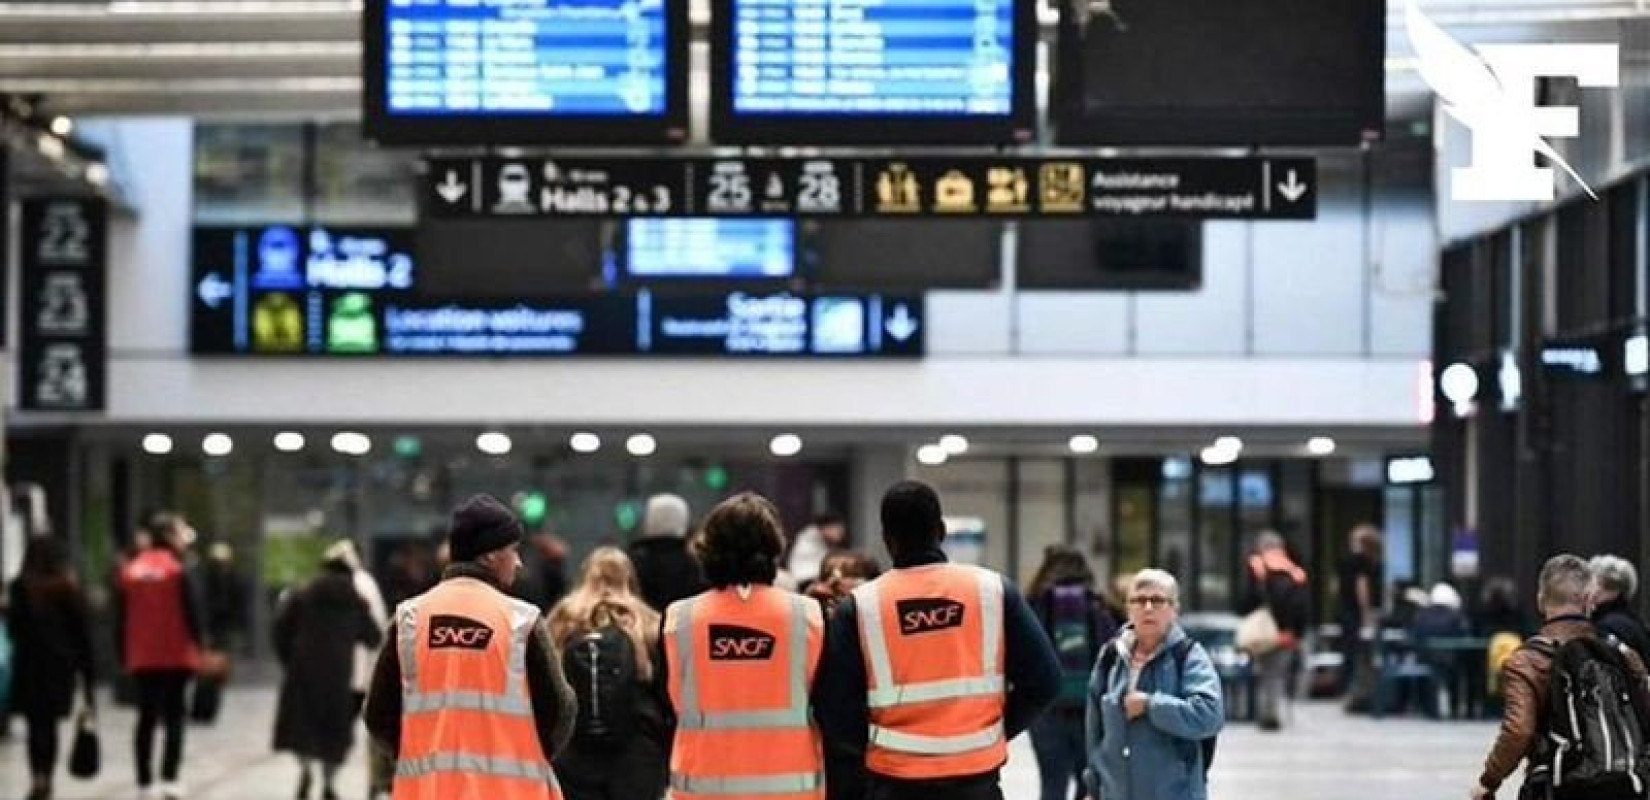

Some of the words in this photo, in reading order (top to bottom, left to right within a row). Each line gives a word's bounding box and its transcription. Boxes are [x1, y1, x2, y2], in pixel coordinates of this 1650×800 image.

[709, 174, 751, 208] 25
[798, 174, 840, 208] 28
[1092, 171, 1180, 189] Assistance
[541, 185, 608, 213] Halls
[612, 185, 631, 213] 2
[652, 185, 671, 213] 3
[1094, 195, 1166, 213] voyageur
[39, 220, 88, 260] 22
[903, 605, 960, 631] SNCF
[431, 626, 489, 645] SNCF
[712, 636, 771, 657] SNCF
